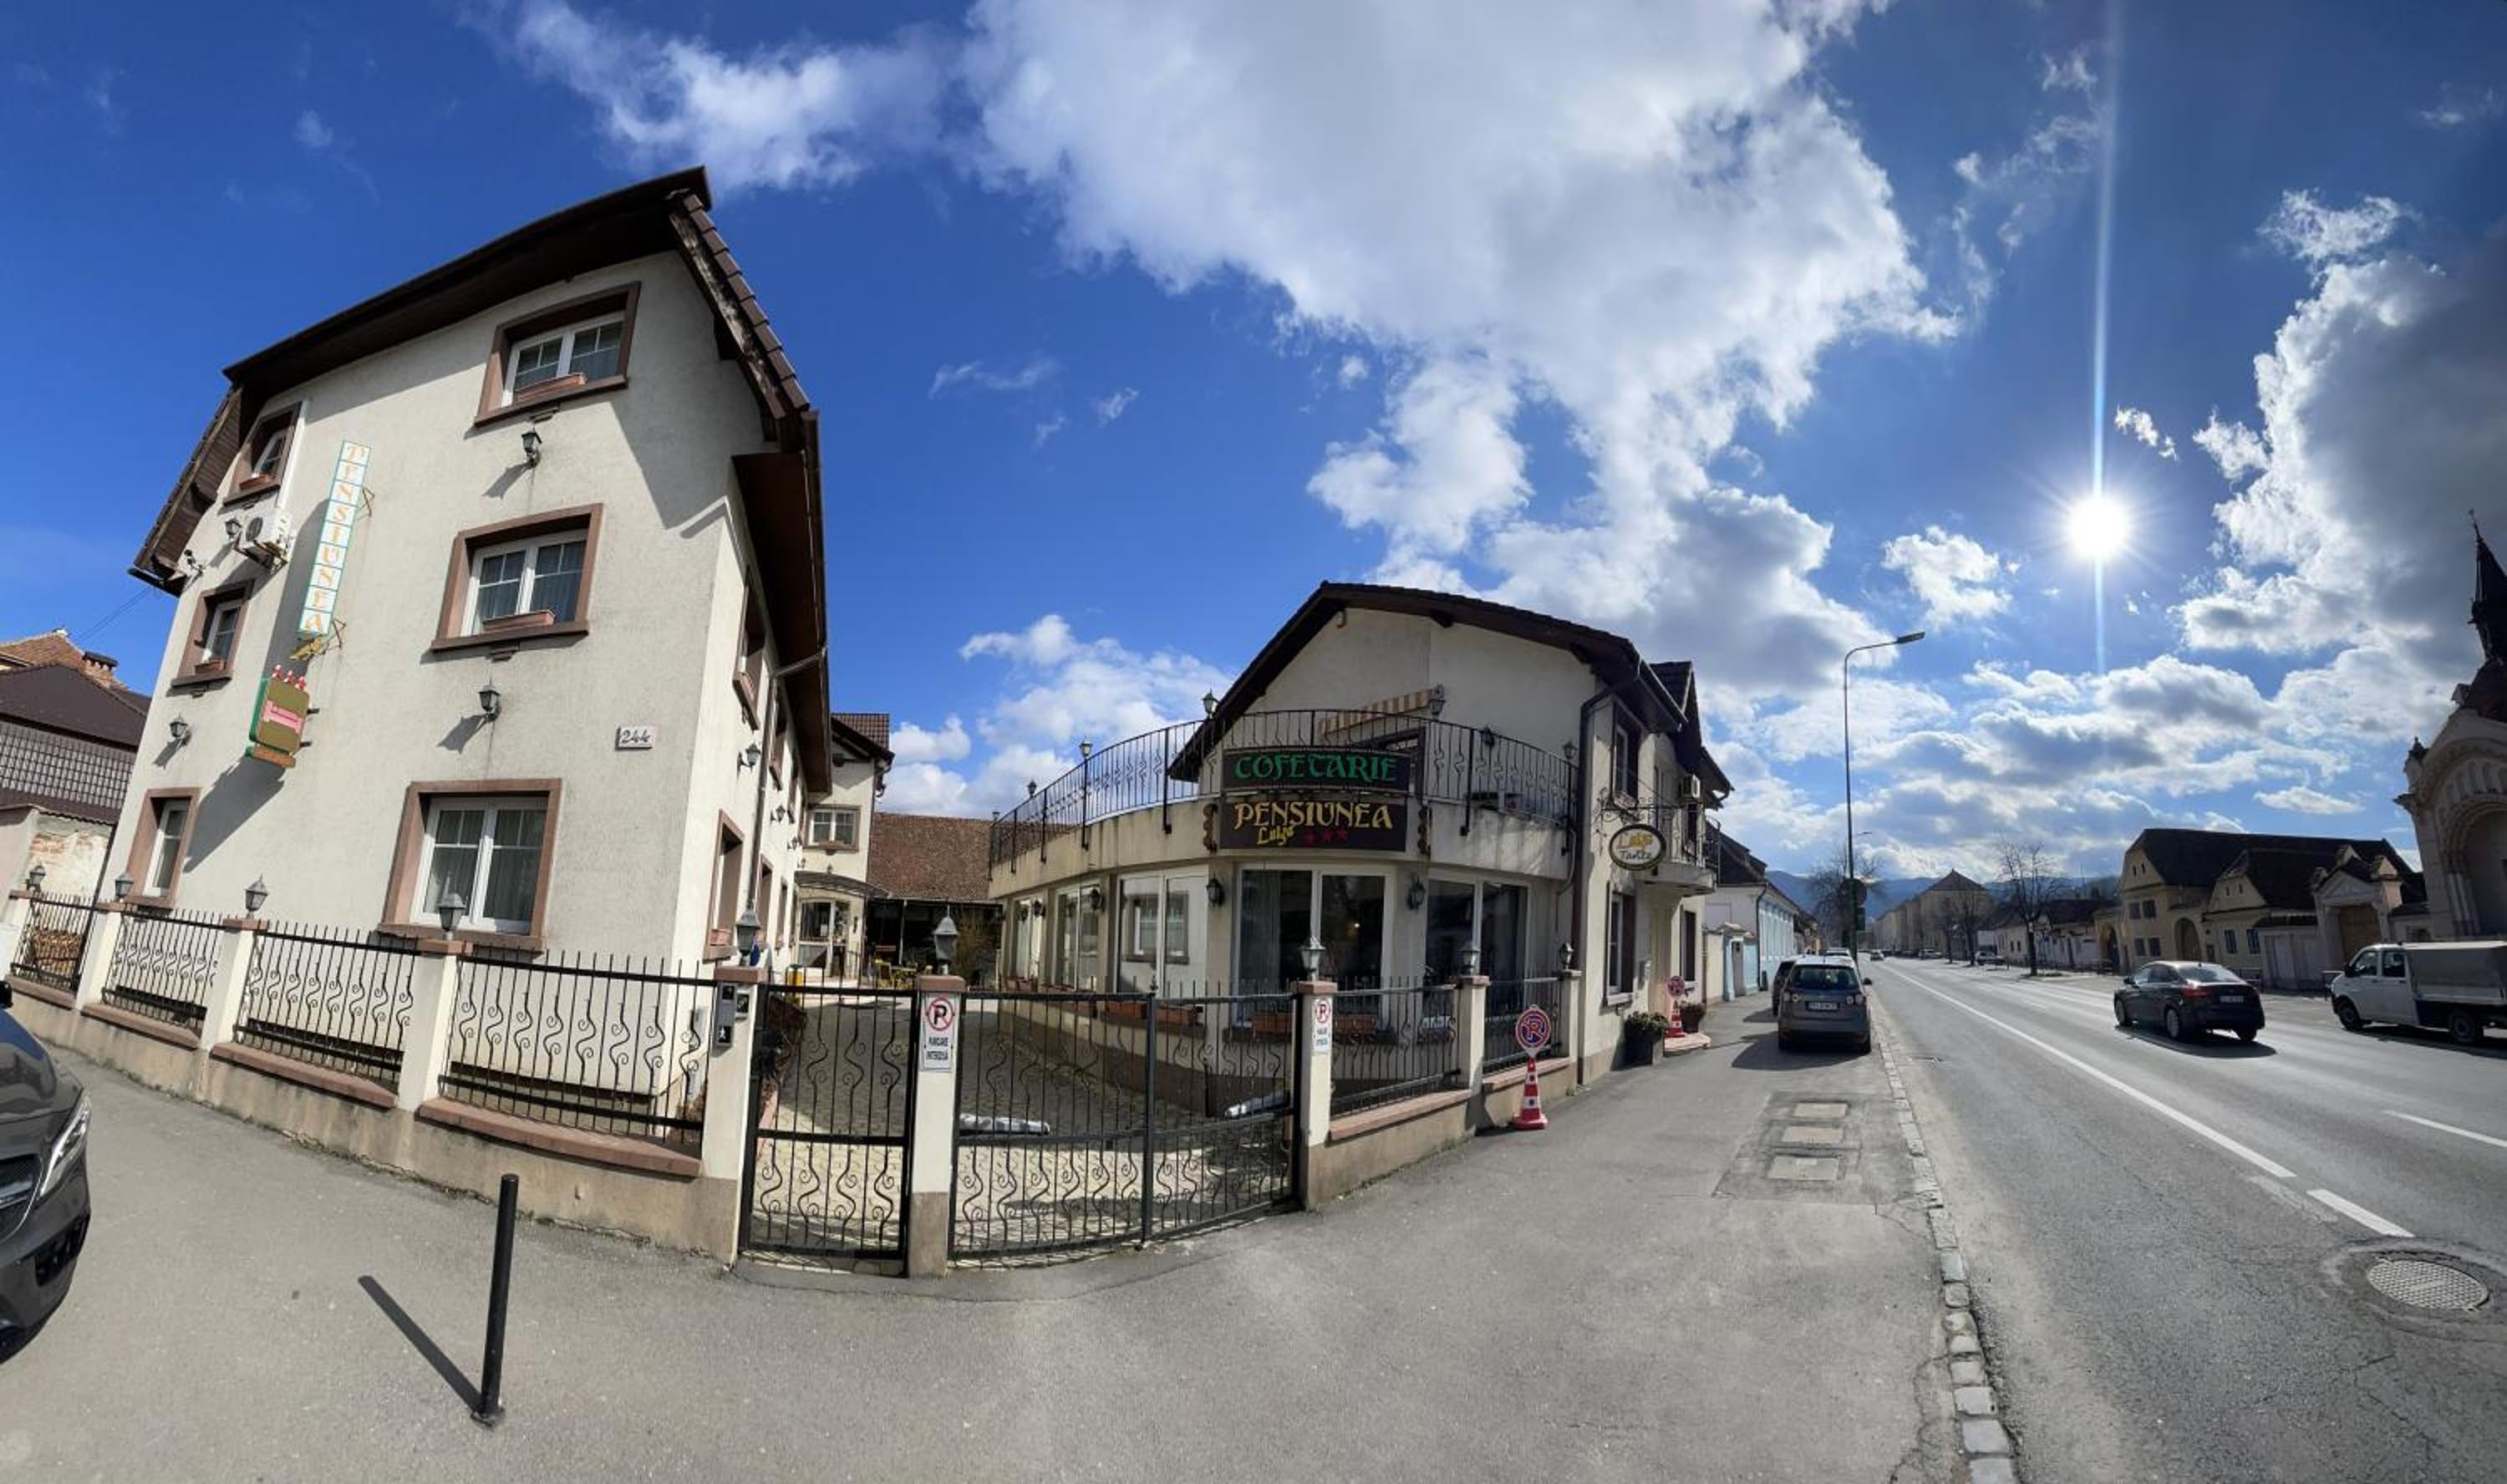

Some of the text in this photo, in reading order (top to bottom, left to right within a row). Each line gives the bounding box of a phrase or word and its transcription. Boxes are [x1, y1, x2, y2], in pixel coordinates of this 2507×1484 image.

[621, 729, 651, 743] 244
[1234, 754, 1397, 782] COFETARIE
[1233, 801, 1393, 829] PENSIUNEA
